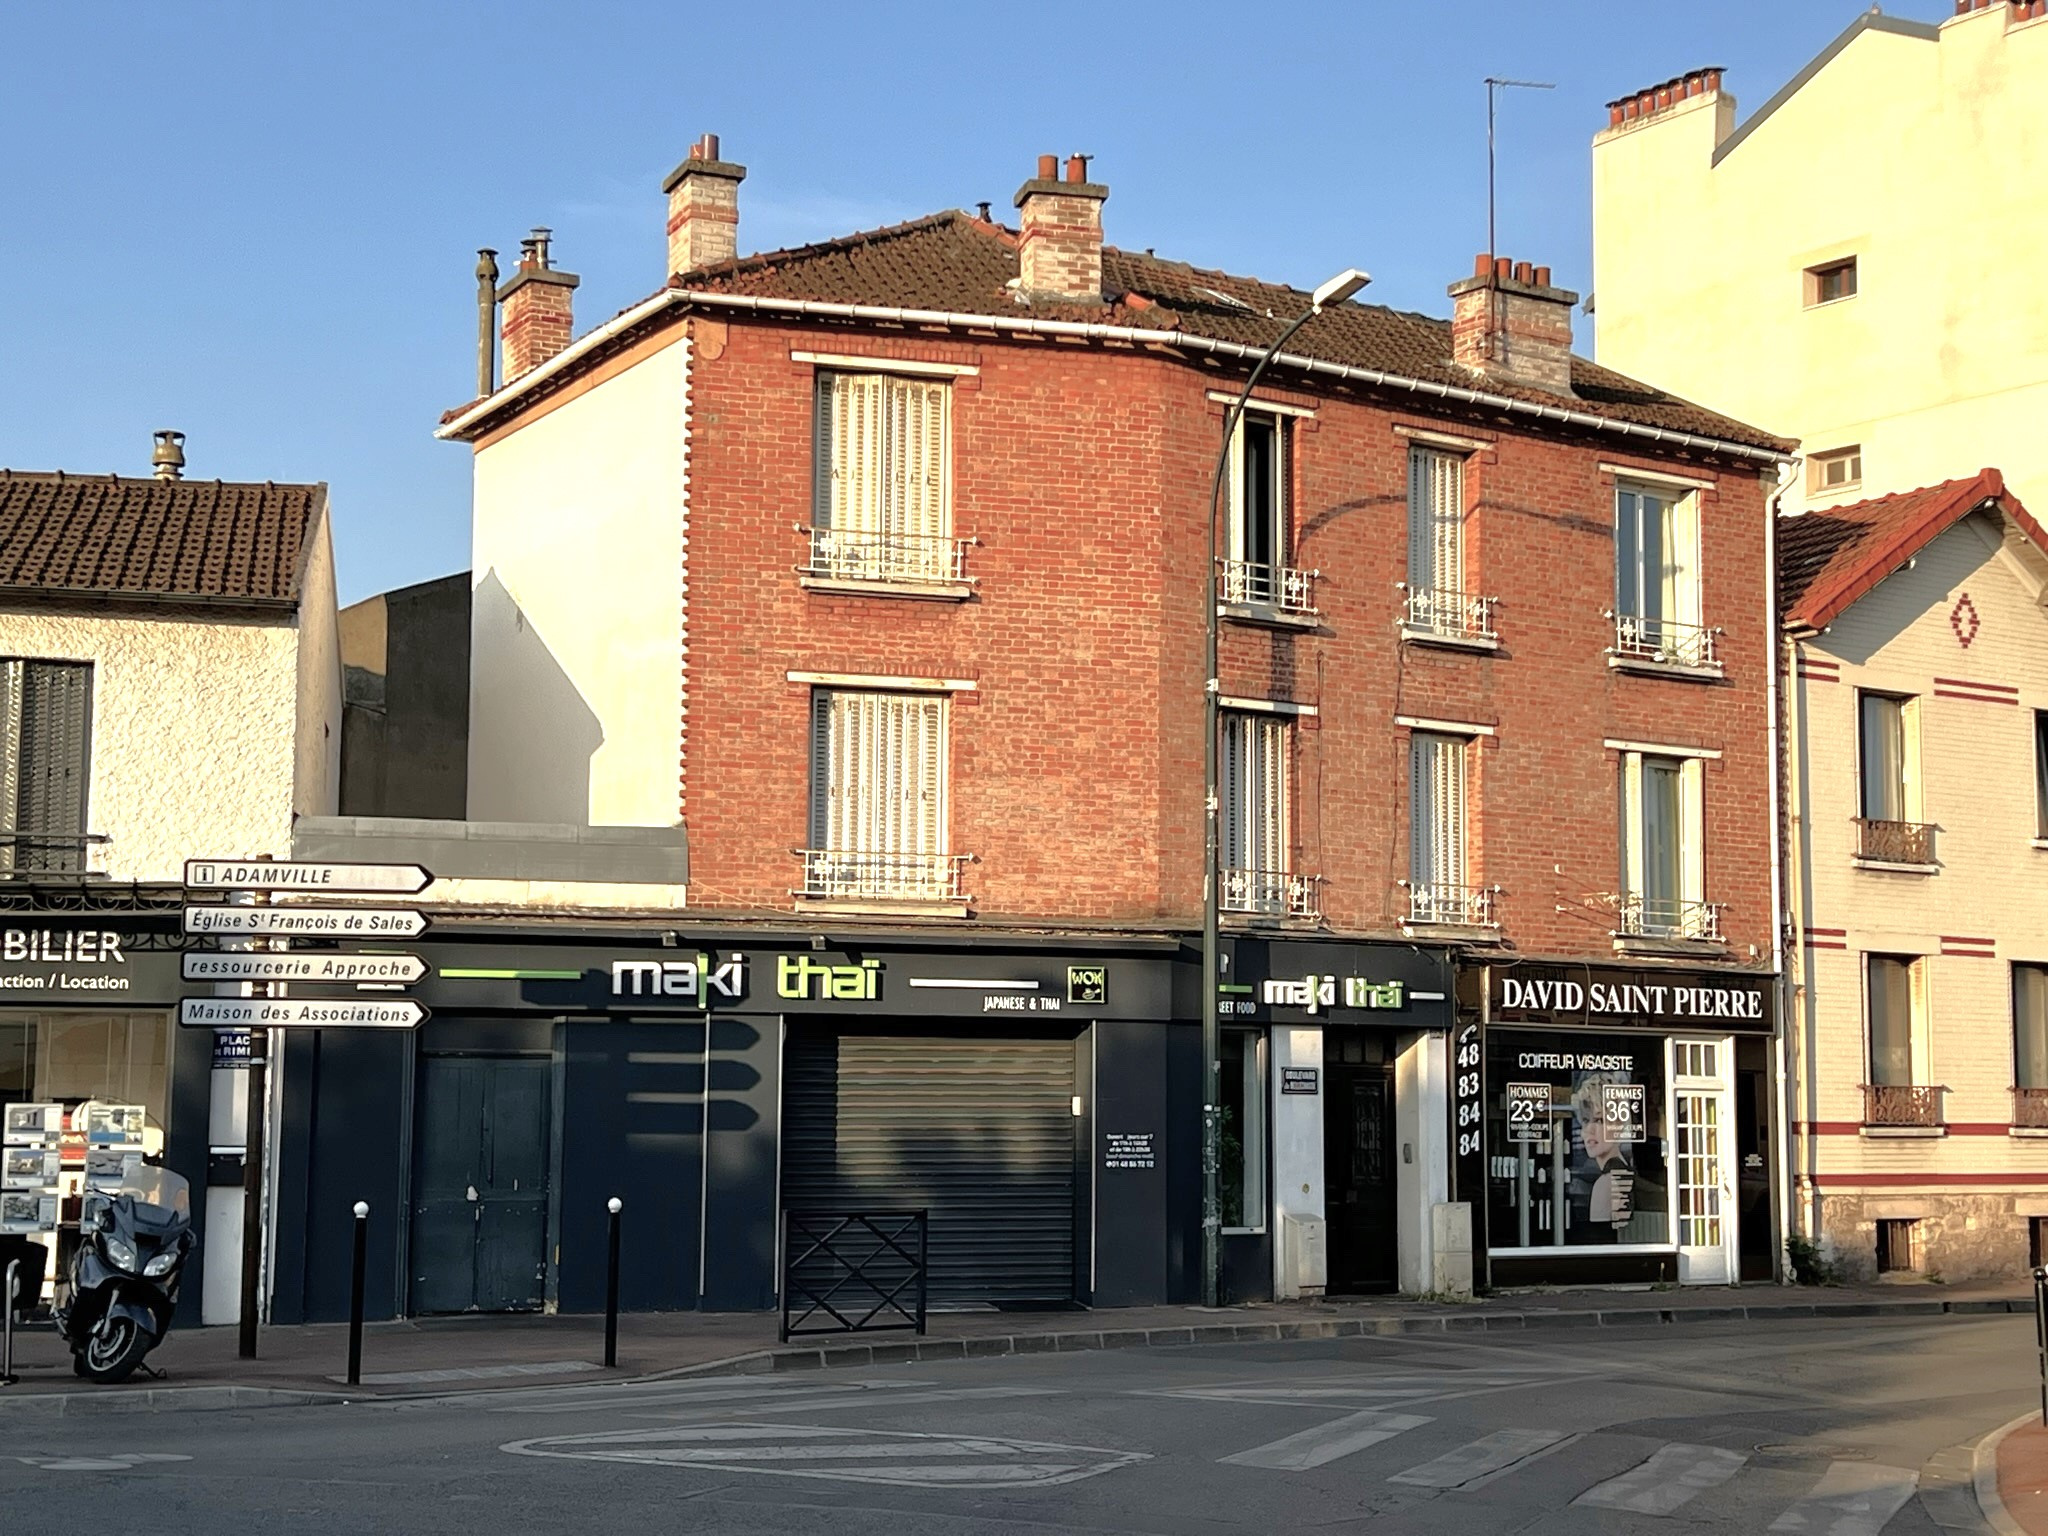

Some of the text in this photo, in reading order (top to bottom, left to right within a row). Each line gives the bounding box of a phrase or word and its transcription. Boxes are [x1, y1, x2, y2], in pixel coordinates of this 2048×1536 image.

[221, 868, 332, 884] ADAMVILLE
[192, 909, 412, 931] Église St François de Sales
[1, 929, 125, 963] BILIER
[190, 960, 411, 979] ressourcerie Approche
[1071, 971, 1102, 985] WOK
[60, 973, 129, 990] Location
[612, 953, 880, 1009] maki thaï
[1263, 975, 1336, 1014] maki
[1502, 978, 1763, 1019] DAVID SAINT PIERRE
[188, 1004, 410, 1022] Maison des Associations
[984, 996, 1060, 1012] JAPANESE & THAI
[1236, 1001, 1257, 1014] FOOD
[220, 1035, 251, 1045] PLAC
[223, 1046, 251, 1056] RIMI
[1458, 1043, 1479, 1068] 48
[1519, 1053, 1633, 1071] COIFFEUR VISAGISTE
[1458, 1072, 1479, 1098] 83
[1510, 1086, 1548, 1099] HOMMES
[1605, 1088, 1642, 1099] FEMMES
[1459, 1101, 1480, 1127] 84
[1459, 1130, 1480, 1156] 84
